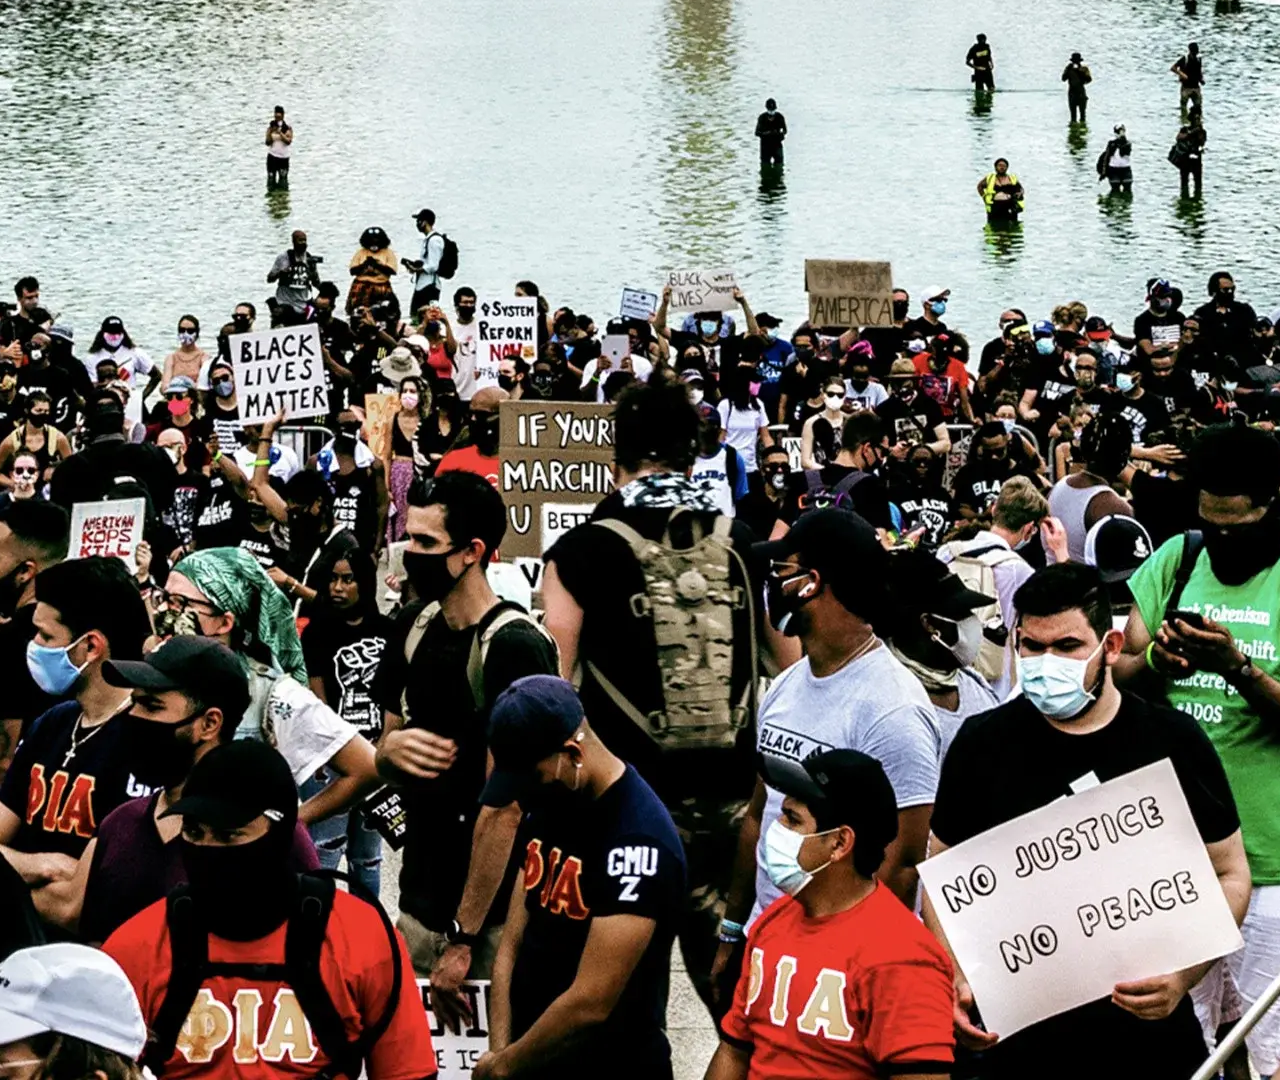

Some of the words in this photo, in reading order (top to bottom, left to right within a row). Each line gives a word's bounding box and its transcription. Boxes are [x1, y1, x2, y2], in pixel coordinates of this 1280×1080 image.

[669, 272, 703, 287] BLACK
[669, 289, 704, 308] LIVES
[813, 296, 893, 326] AMERICA
[239, 333, 315, 364] BLACK
[243, 358, 313, 387] LIVES
[244, 385, 327, 418] MATTER
[518, 412, 547, 447] IF
[554, 410, 616, 448] YOU'R
[509, 505, 532, 535] U
[901, 498, 949, 513] BLACK
[79, 543, 131, 558] KILL
[81, 528, 133, 544] KOPS
[1204, 604, 1271, 626] Tokenism
[759, 728, 805, 757] BLACK
[607, 846, 659, 877] GMU
[941, 864, 997, 913] NO
[1015, 796, 1165, 878] JUSTICE
[618, 876, 642, 902] Z
[999, 924, 1059, 973] NO
[1077, 870, 1200, 937] PEACE
